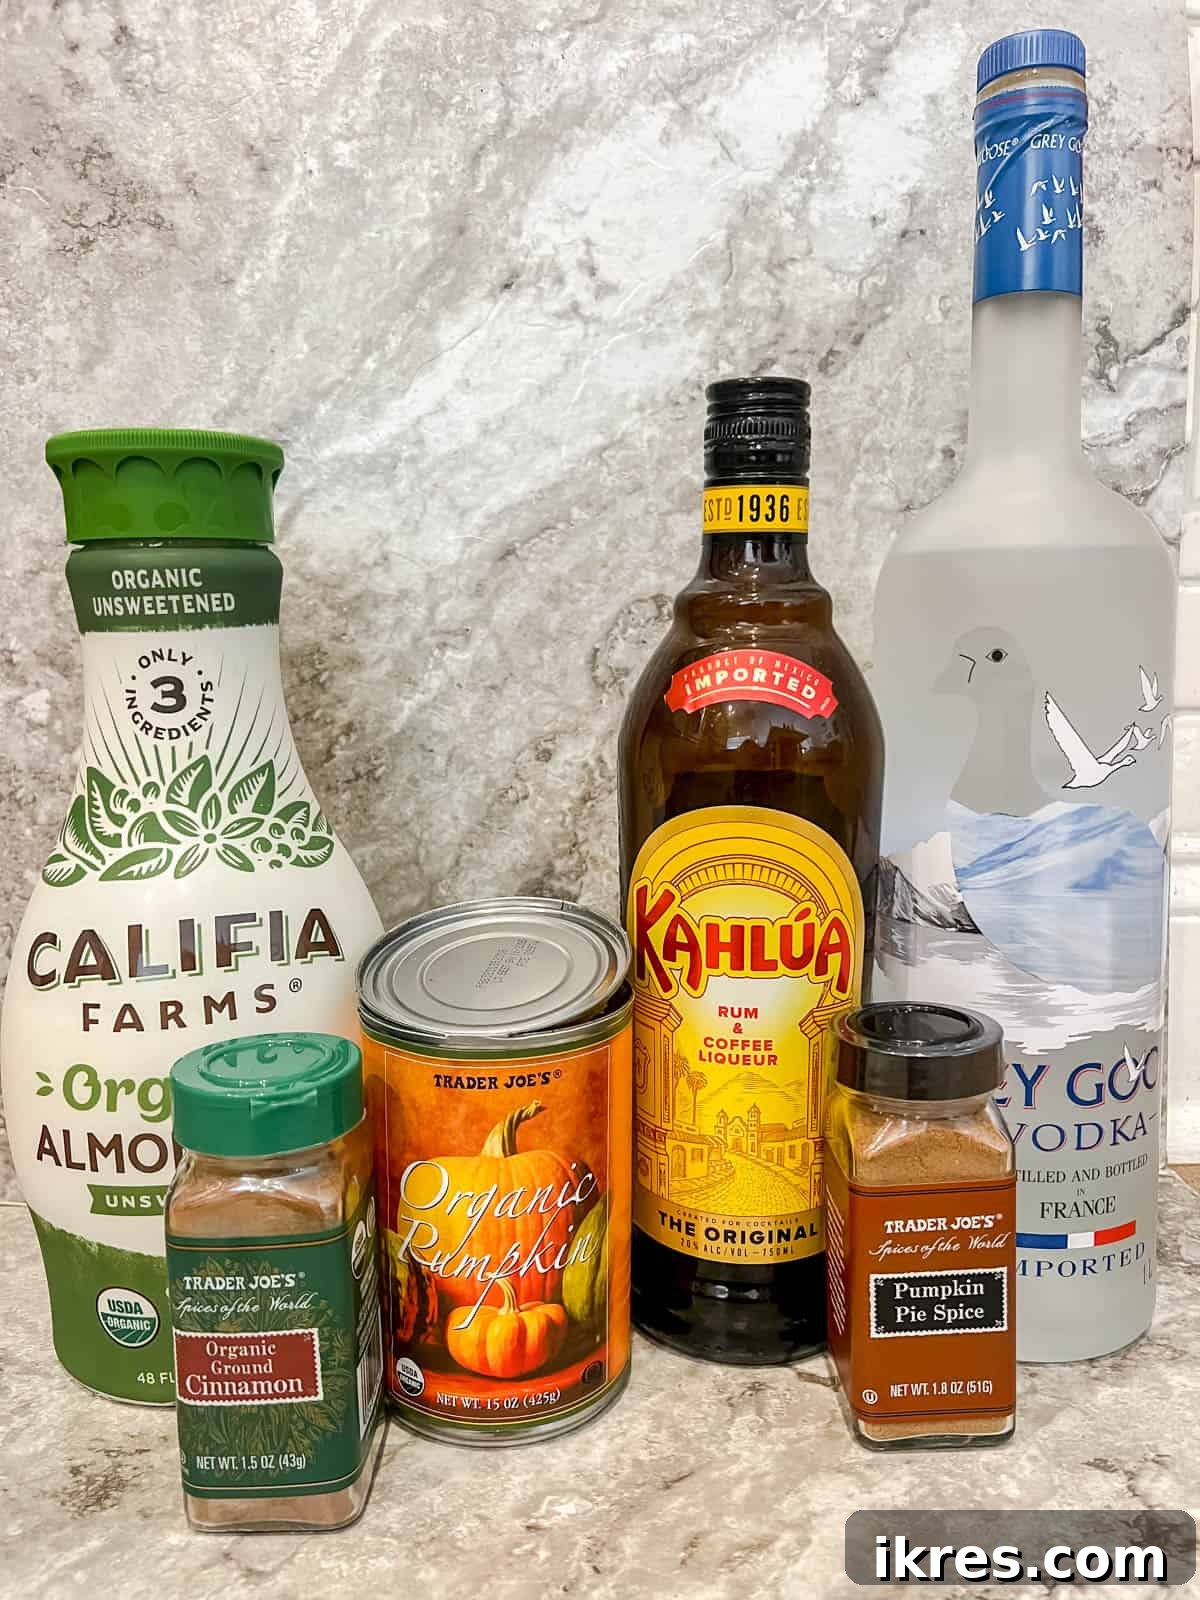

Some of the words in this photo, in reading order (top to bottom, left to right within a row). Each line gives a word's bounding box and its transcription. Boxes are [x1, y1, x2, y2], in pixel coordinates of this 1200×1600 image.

[1030, 133, 1066, 150] GREY
[738, 494, 789, 522] 1936
[111, 568, 203, 590] ORGANIC
[93, 592, 236, 617] UNSWEETENED
[138, 648, 193, 669] ONLY
[684, 667, 816, 699] IMPORTED
[150, 675, 187, 714] 3
[125, 680, 215, 741] INGREDIENTS
[27, 908, 344, 989] CALIFIA
[635, 884, 851, 994] KAHLÚA
[718, 1006, 759, 1019] RUM
[732, 1023, 743, 1034] &
[703, 1036, 773, 1051] COFFEE
[699, 1051, 778, 1066] LIQUEUR
[433, 1074, 498, 1090] TRADER
[36, 1125, 183, 1174] ALMO
[1072, 1170, 1101, 1183] AND
[1105, 1152, 1149, 1179] BOTTLED
[1076, 1188, 1086, 1196] IN
[400, 1160, 600, 1262] Organic
[1040, 1195, 1117, 1219] FRANCE
[658, 1210, 696, 1236] THE
[704, 1223, 818, 1245] ORIGINAL
[884, 1218, 947, 1234] TRADER
[869, 1239, 920, 1262] Spices
[968, 1232, 1011, 1250] World
[397, 1206, 599, 1330] Pumpkin
[183, 1276, 246, 1290] TRADER
[893, 1279, 985, 1300] Pumpkin
[107, 1299, 143, 1315] USDA
[175, 1297, 219, 1319] Spices
[269, 1292, 319, 1312] World
[894, 1305, 928, 1323] Pie
[933, 1303, 985, 1324] Spice
[106, 1317, 151, 1331] ORGANIC
[206, 1340, 277, 1359] Organic
[211, 1359, 273, 1375] Ground
[137, 1372, 156, 1384] 48
[185, 1374, 303, 1396] Cinnamon
[436, 1391, 460, 1407] NET
[461, 1395, 482, 1409] WT.
[487, 1398, 500, 1411] 15
[503, 1396, 520, 1409] OZ
[523, 1387, 561, 1408] (425g)
[890, 1384, 910, 1398] NET
[911, 1382, 930, 1396] WT.
[950, 1381, 964, 1395] OZ
[196, 1455, 217, 1470] NET
[218, 1455, 239, 1471] WT.
[242, 1455, 258, 1470] 1.5
[260, 1454, 275, 1469] OZ
[278, 1453, 306, 1470] (43g)
